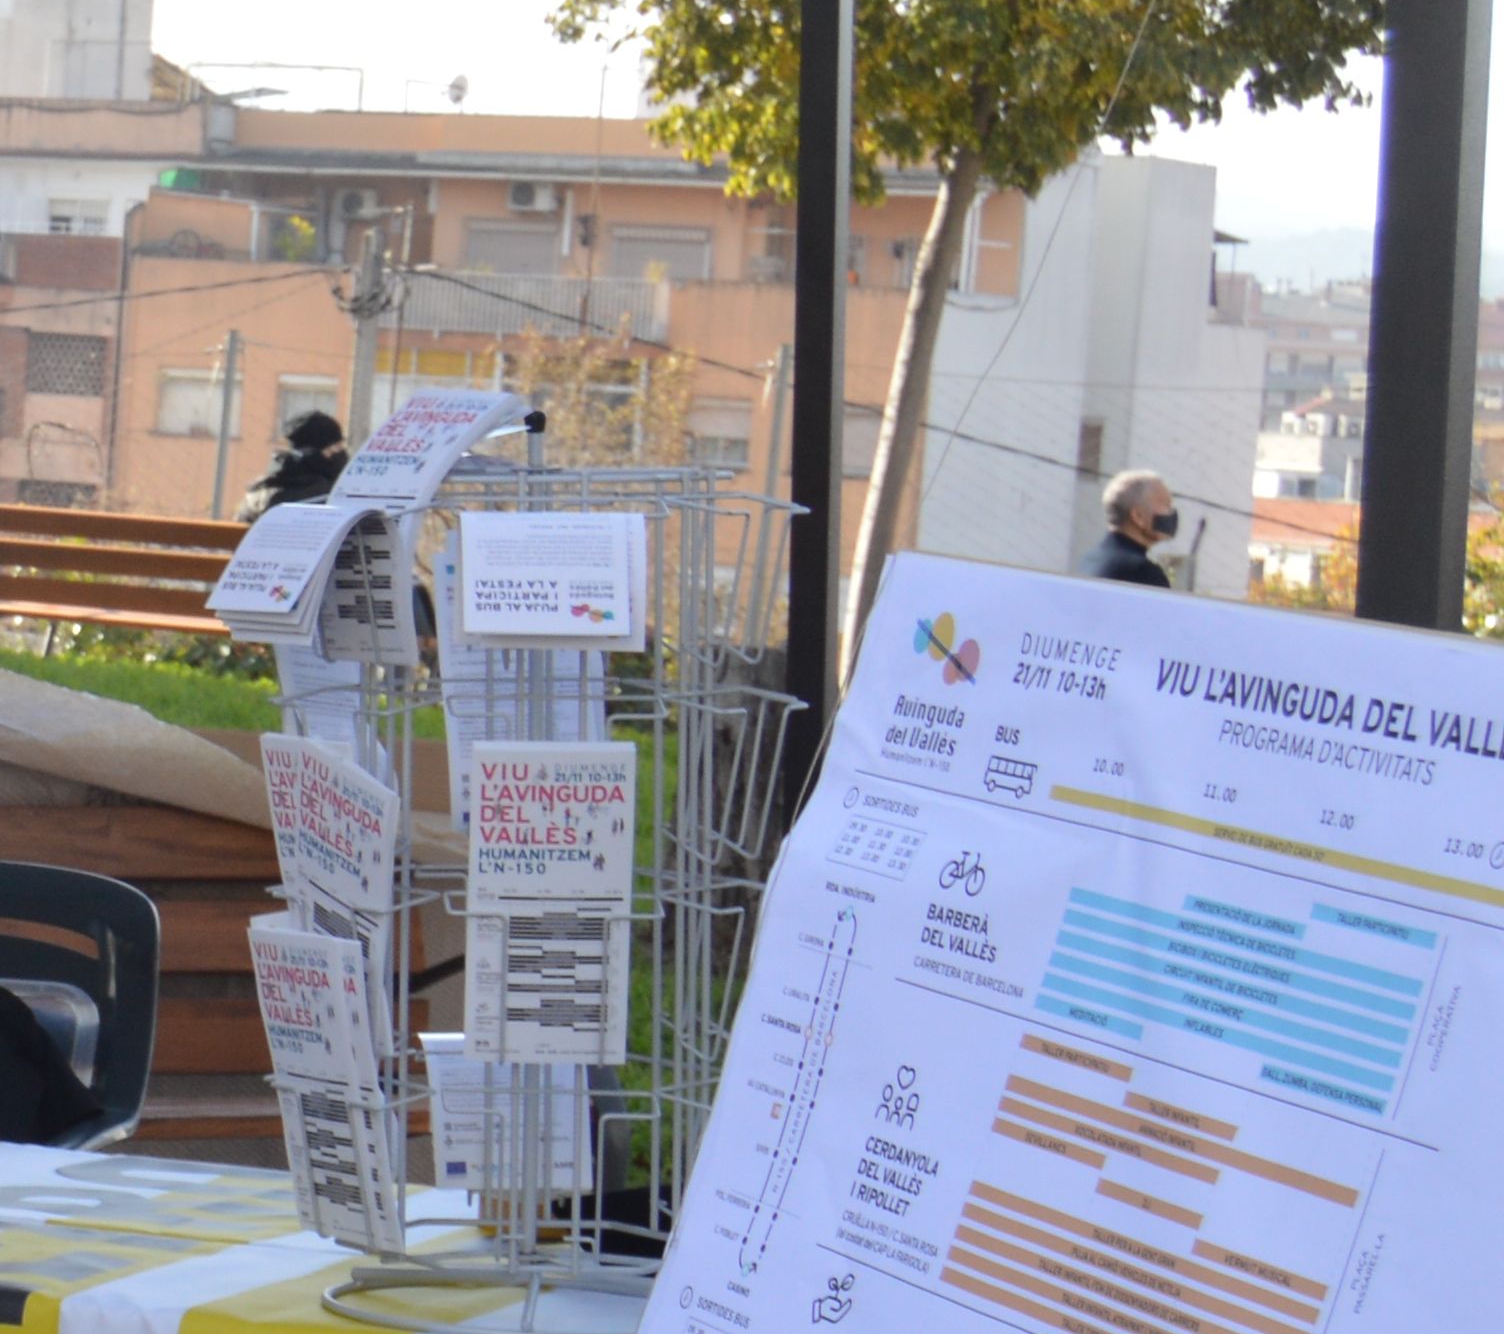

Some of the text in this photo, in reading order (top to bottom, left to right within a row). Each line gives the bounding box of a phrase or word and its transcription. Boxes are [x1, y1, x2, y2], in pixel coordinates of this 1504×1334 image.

[1021, 632, 1122, 671] DIUMENGE
[1012, 662, 1107, 701] 21/11 10-13h
[1156, 658, 1504, 761] VIU L'AVINGUDA DEL VALL
[995, 725, 1021, 746] BUS
[1218, 719, 1437, 787] PROGRAMA D'ACTIVITATS
[302, 750, 329, 781] VIU
[481, 763, 529, 781] VIU
[1093, 758, 1125, 777] 10.00
[554, 772, 626, 783] 21/11 10-13h
[480, 784, 625, 803] L'AVINGUDA
[1203, 783, 1238, 804] 11.00
[300, 789, 327, 822] DEL
[480, 805, 530, 823] DEL
[1320, 809, 1355, 830] 12.00
[479, 822, 578, 845] VALLÈS
[478, 848, 591, 861] HUMANITZEM
[1444, 838, 1484, 860] 13.00
[927, 903, 989, 936] BARBERÀ
[253, 942, 278, 961] VIU
[921, 926, 997, 963] DEL VALLÈS
[913, 955, 1024, 999] CARRETERA DE BARCELONA
[865, 1135, 939, 1178] CERDANYOLA
[857, 1157, 923, 1198] DEL VALLÈS
[857, 1183, 911, 1218] RIPOLLET
[733, 1309, 751, 1330] BUS
